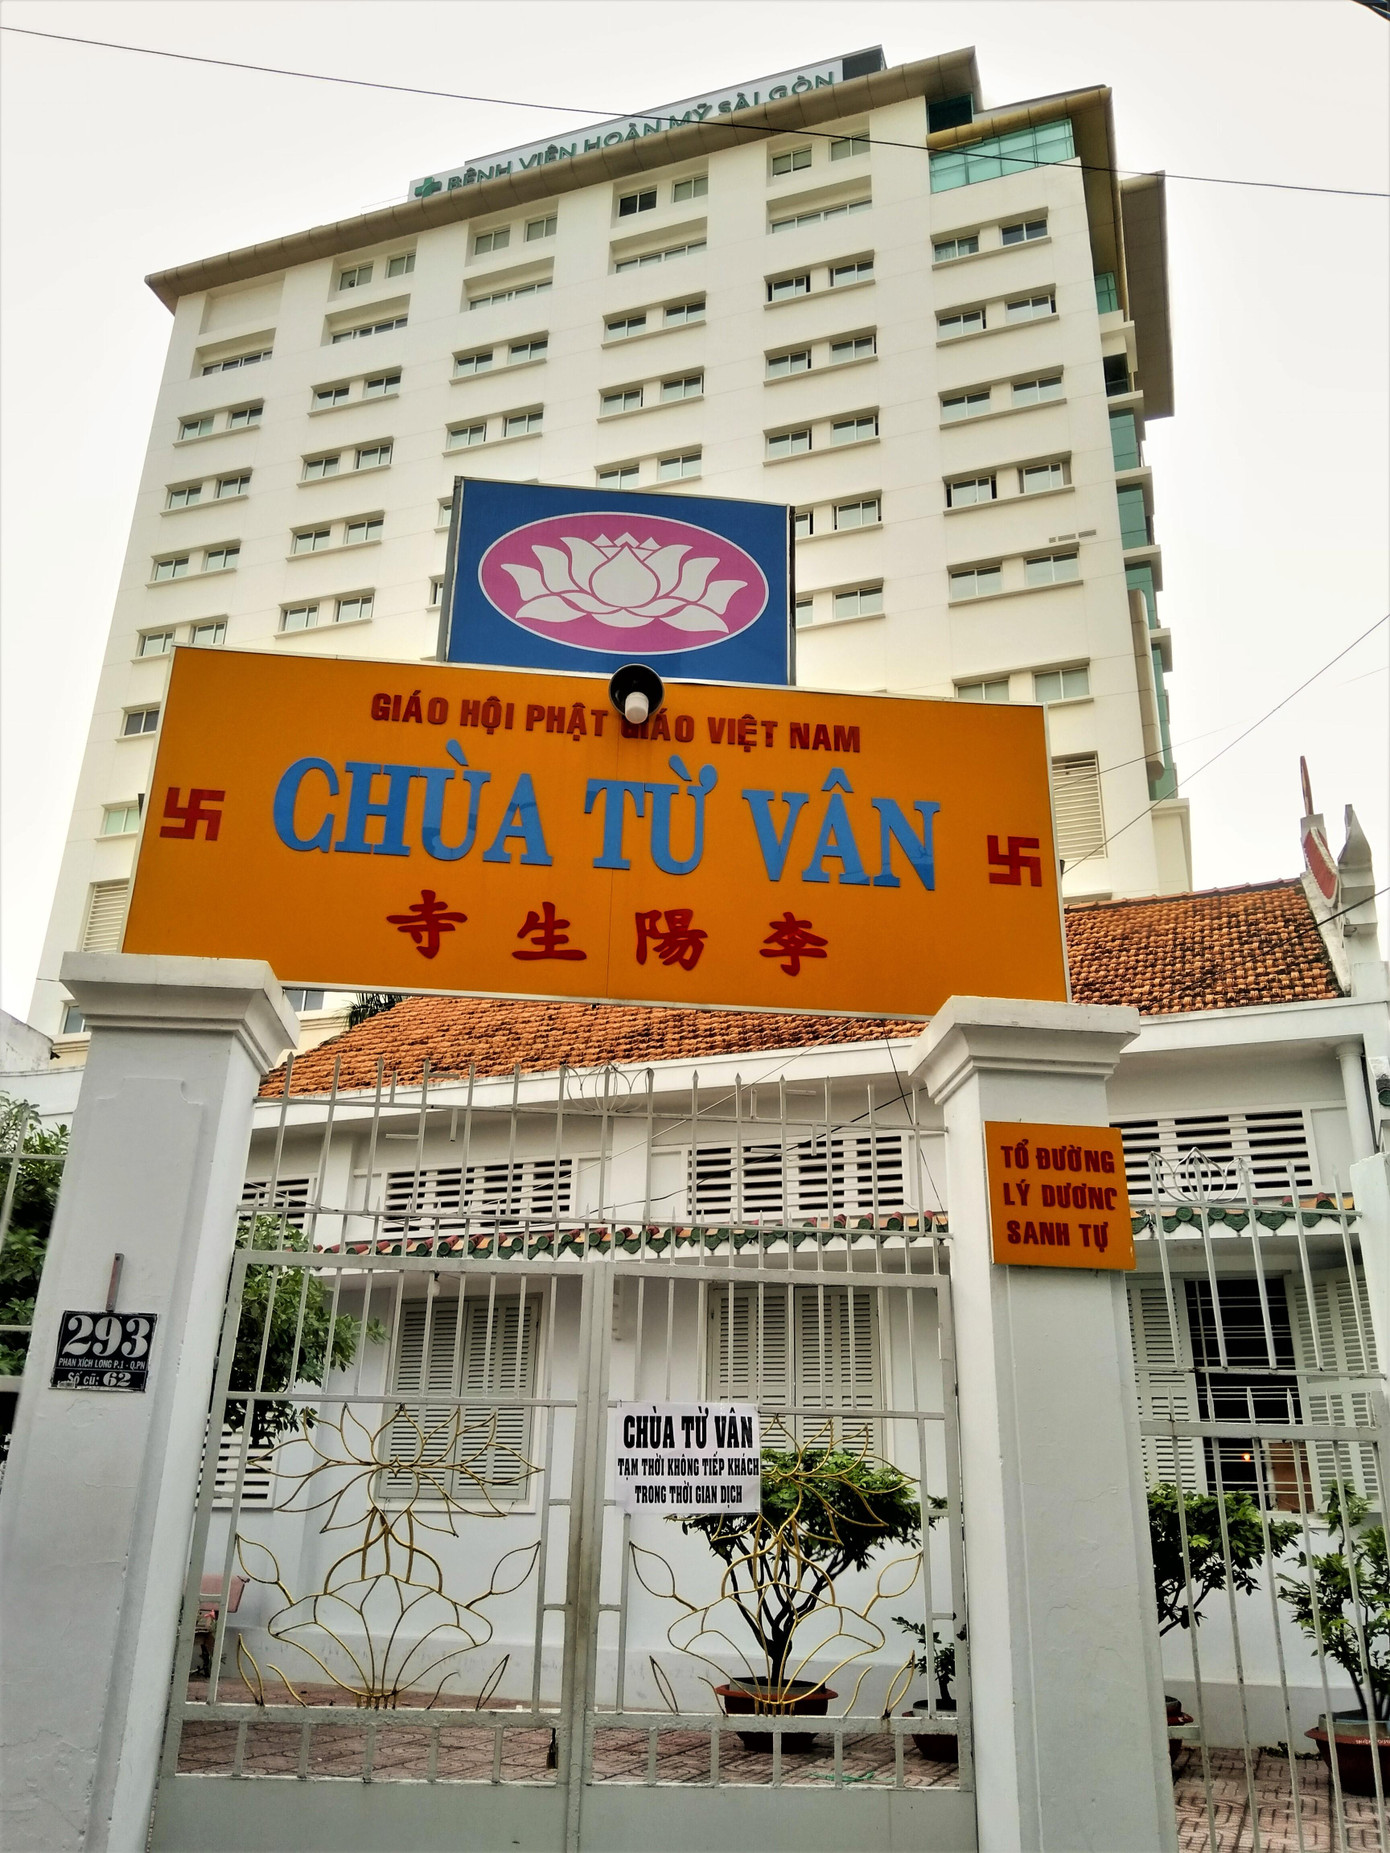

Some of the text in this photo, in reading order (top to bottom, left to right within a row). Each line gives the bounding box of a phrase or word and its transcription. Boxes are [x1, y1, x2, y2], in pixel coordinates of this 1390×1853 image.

[584, 121, 661, 152] HOÀN
[669, 103, 712, 127] MỸ
[718, 92, 759, 115] SÀI
[769, 71, 834, 101] GÒN
[371, 690, 449, 725] GIÁO
[460, 696, 513, 735] HỘI
[525, 702, 608, 741] PHẬT
[708, 714, 778, 752] VIỆT
[790, 722, 860, 753] NAM
[273, 739, 940, 891] CHÙA TỪ VÂN
[1000, 1138, 1115, 1174] TỔ ĐƯỜNG
[1003, 1179, 1030, 1206] LÝ
[1006, 1220, 1109, 1253] SANH TỰ
[62, 1315, 150, 1358] 293
[58, 1358, 77, 1367] PHAN
[77, 1357, 93, 1368] XÍCH
[94, 1359, 112, 1369] LONG
[113, 1360, 124, 1369] P.1
[130, 1360, 146, 1371] Q.PN
[68, 1371, 131, 1387] Số cũ: 62
[623, 1405, 753, 1449] CHÙA TỪ VÂN
[617, 1451, 759, 1480] TẠM THỜI KHÔNG TIẾP KHÁCH
[634, 1480, 742, 1508] TRONG THỜI GIAN DỊCH
